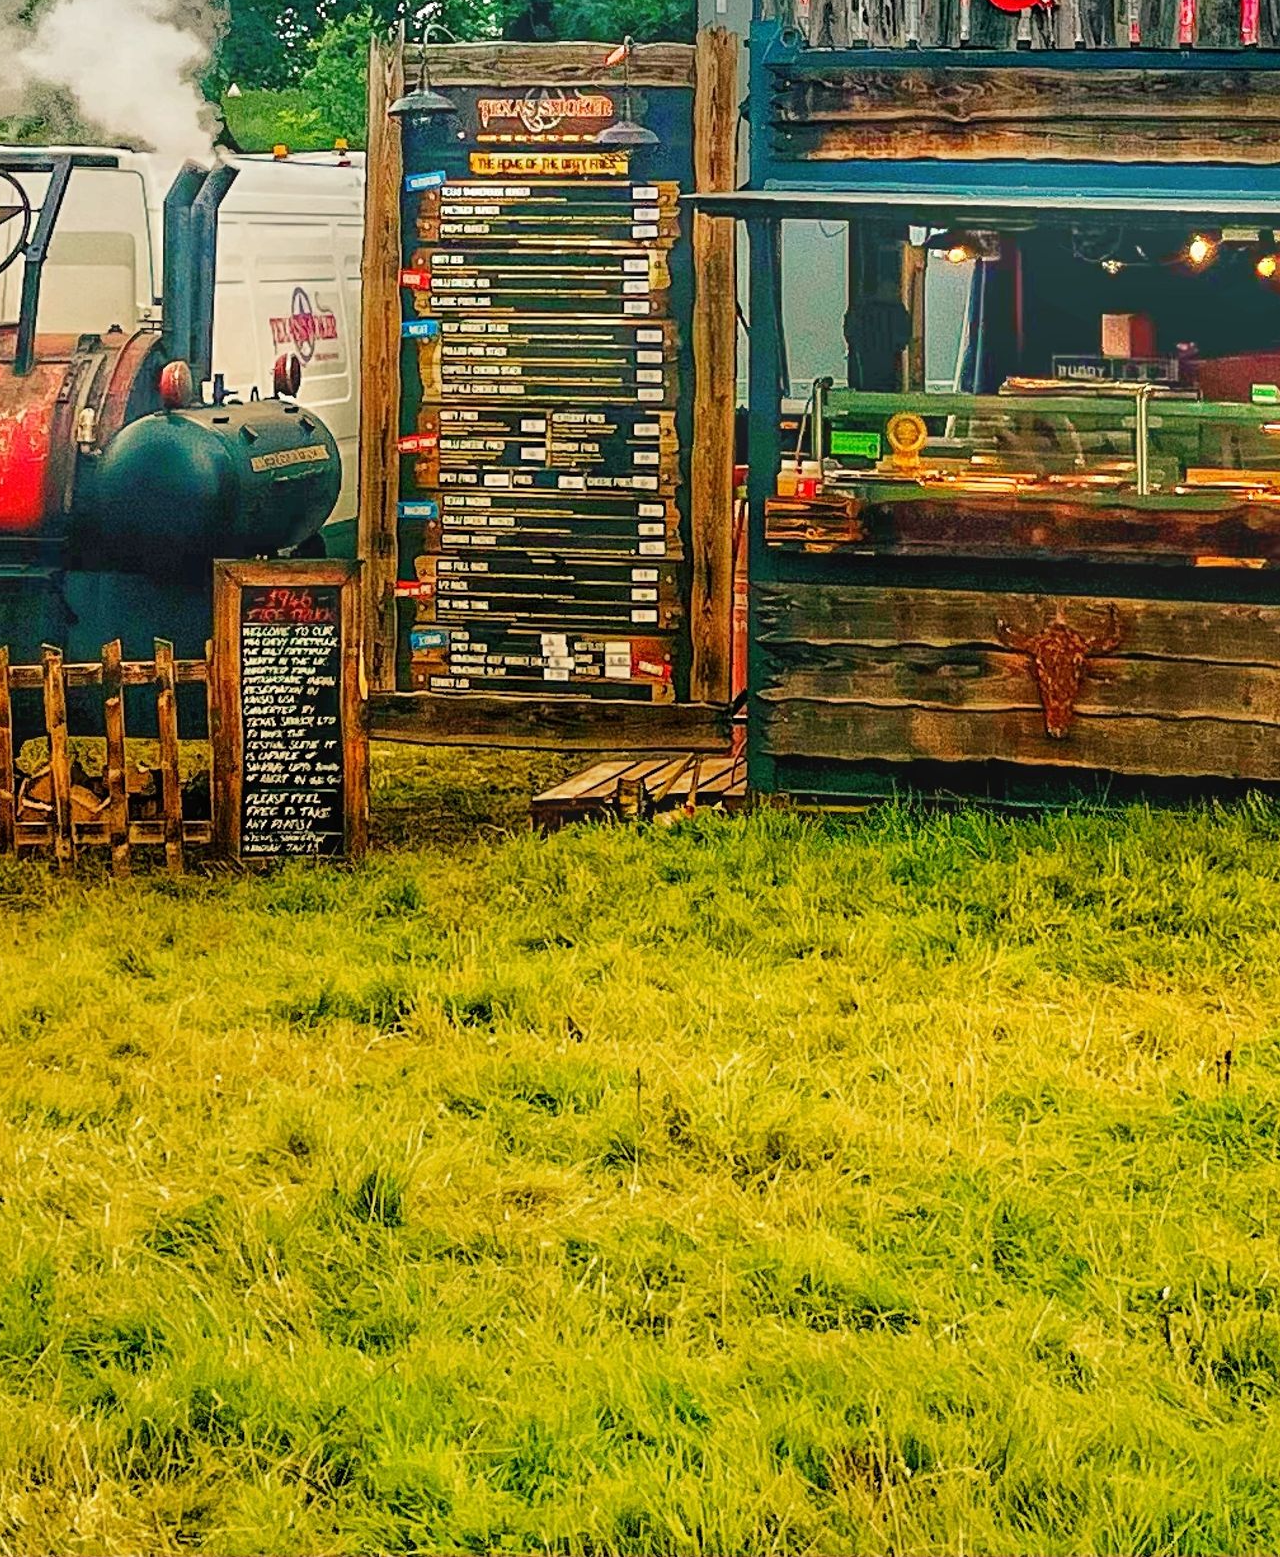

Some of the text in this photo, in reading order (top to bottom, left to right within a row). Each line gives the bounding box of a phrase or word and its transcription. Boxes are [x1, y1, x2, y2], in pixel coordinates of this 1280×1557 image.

[478, 97, 614, 129] TEXAS SMOKER
[478, 158, 494, 171] THE
[497, 158, 523, 171] HOME
[526, 158, 538, 171] OF
[542, 158, 560, 171] THE
[243, 626, 290, 637] WELCOME
[295, 626, 309, 637] TO
[290, 793, 321, 804] FEEL
[246, 806, 280, 817] FREE
